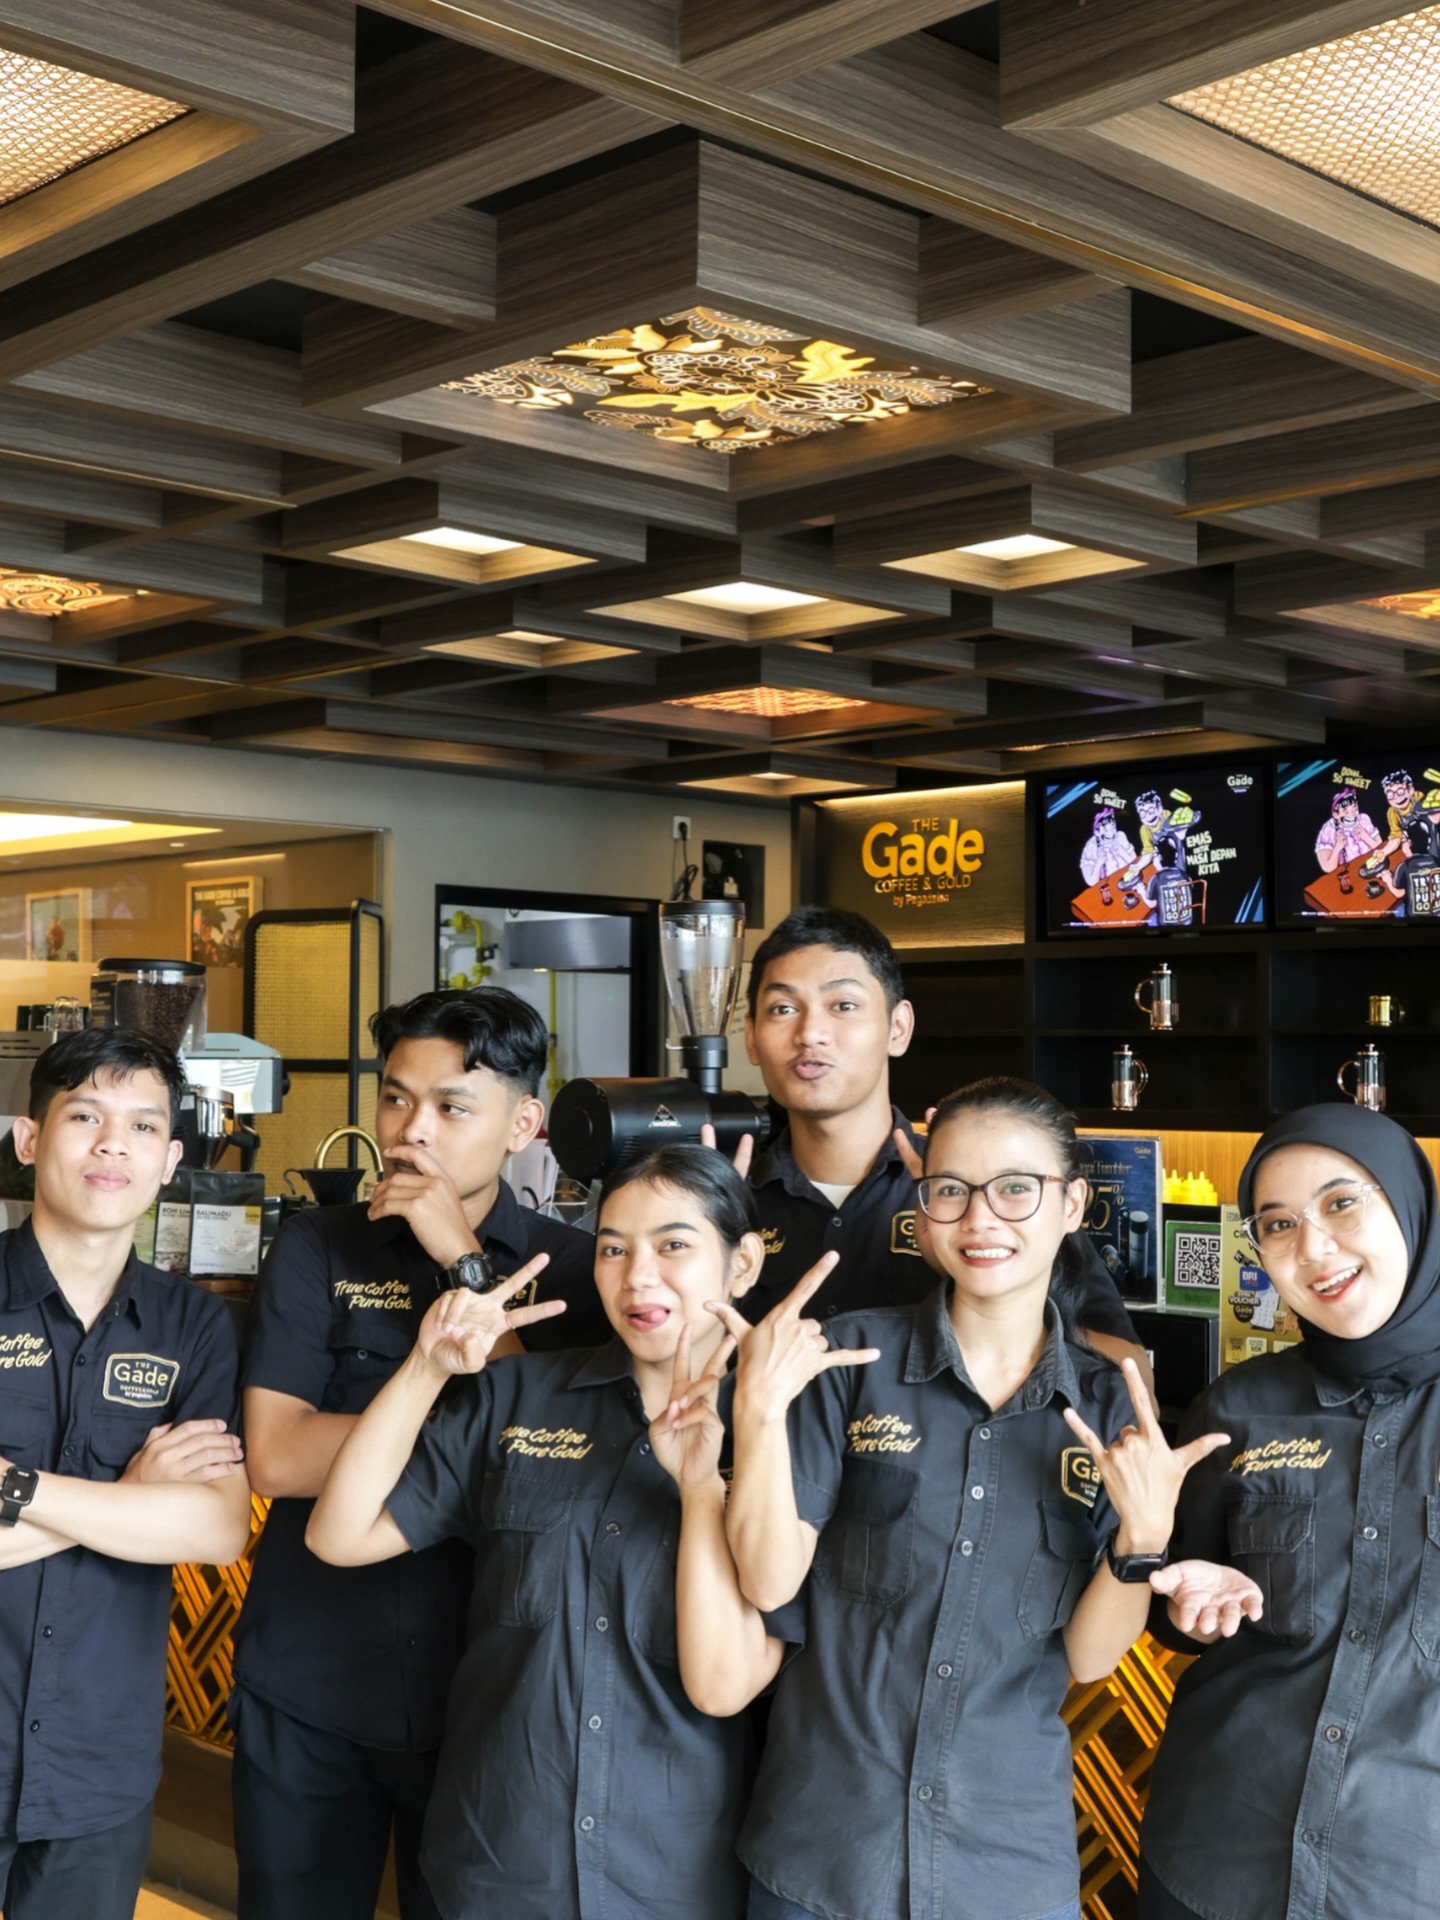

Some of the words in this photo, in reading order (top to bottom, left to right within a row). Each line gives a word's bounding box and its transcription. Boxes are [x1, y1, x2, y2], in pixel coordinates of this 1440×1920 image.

[1227, 775, 1253, 786] Gade
[1333, 772, 1342, 784] SO
[1345, 777, 1371, 789] SWEET
[911, 817, 940, 832] THE
[1187, 831, 1212, 847] EMAS
[861, 817, 985, 879] Gade
[1187, 852, 1208, 865] MASA
[1211, 848, 1236, 862] DEPAN
[1199, 862, 1219, 876] KITA
[874, 878, 919, 894] COFFEE
[922, 876, 933, 891] &
[936, 873, 972, 890] GOLD
[1167, 910, 1188, 919] GOD
[1242, 1271, 1258, 1281] BRI
[334, 1280, 364, 1297] True
[364, 1280, 409, 1296] Coffee
[348, 1295, 384, 1310] Pure
[1229, 1296, 1260, 1305] VOUCHER
[0, 1356, 15, 1369] re
[15, 1348, 53, 1368] Gold
[134, 1361, 151, 1369] THE
[114, 1362, 169, 1388] Gade
[861, 1413, 913, 1436] Coffee
[529, 1427, 587, 1444] Coffee
[877, 1433, 921, 1453] Gold
[507, 1439, 550, 1458] Pure
[549, 1442, 593, 1460] Gold
[1262, 1437, 1321, 1458] Coffee
[1071, 1456, 1101, 1484] Ga
[1241, 1457, 1287, 1477] Pure
[1286, 1448, 1333, 1469] Gold
